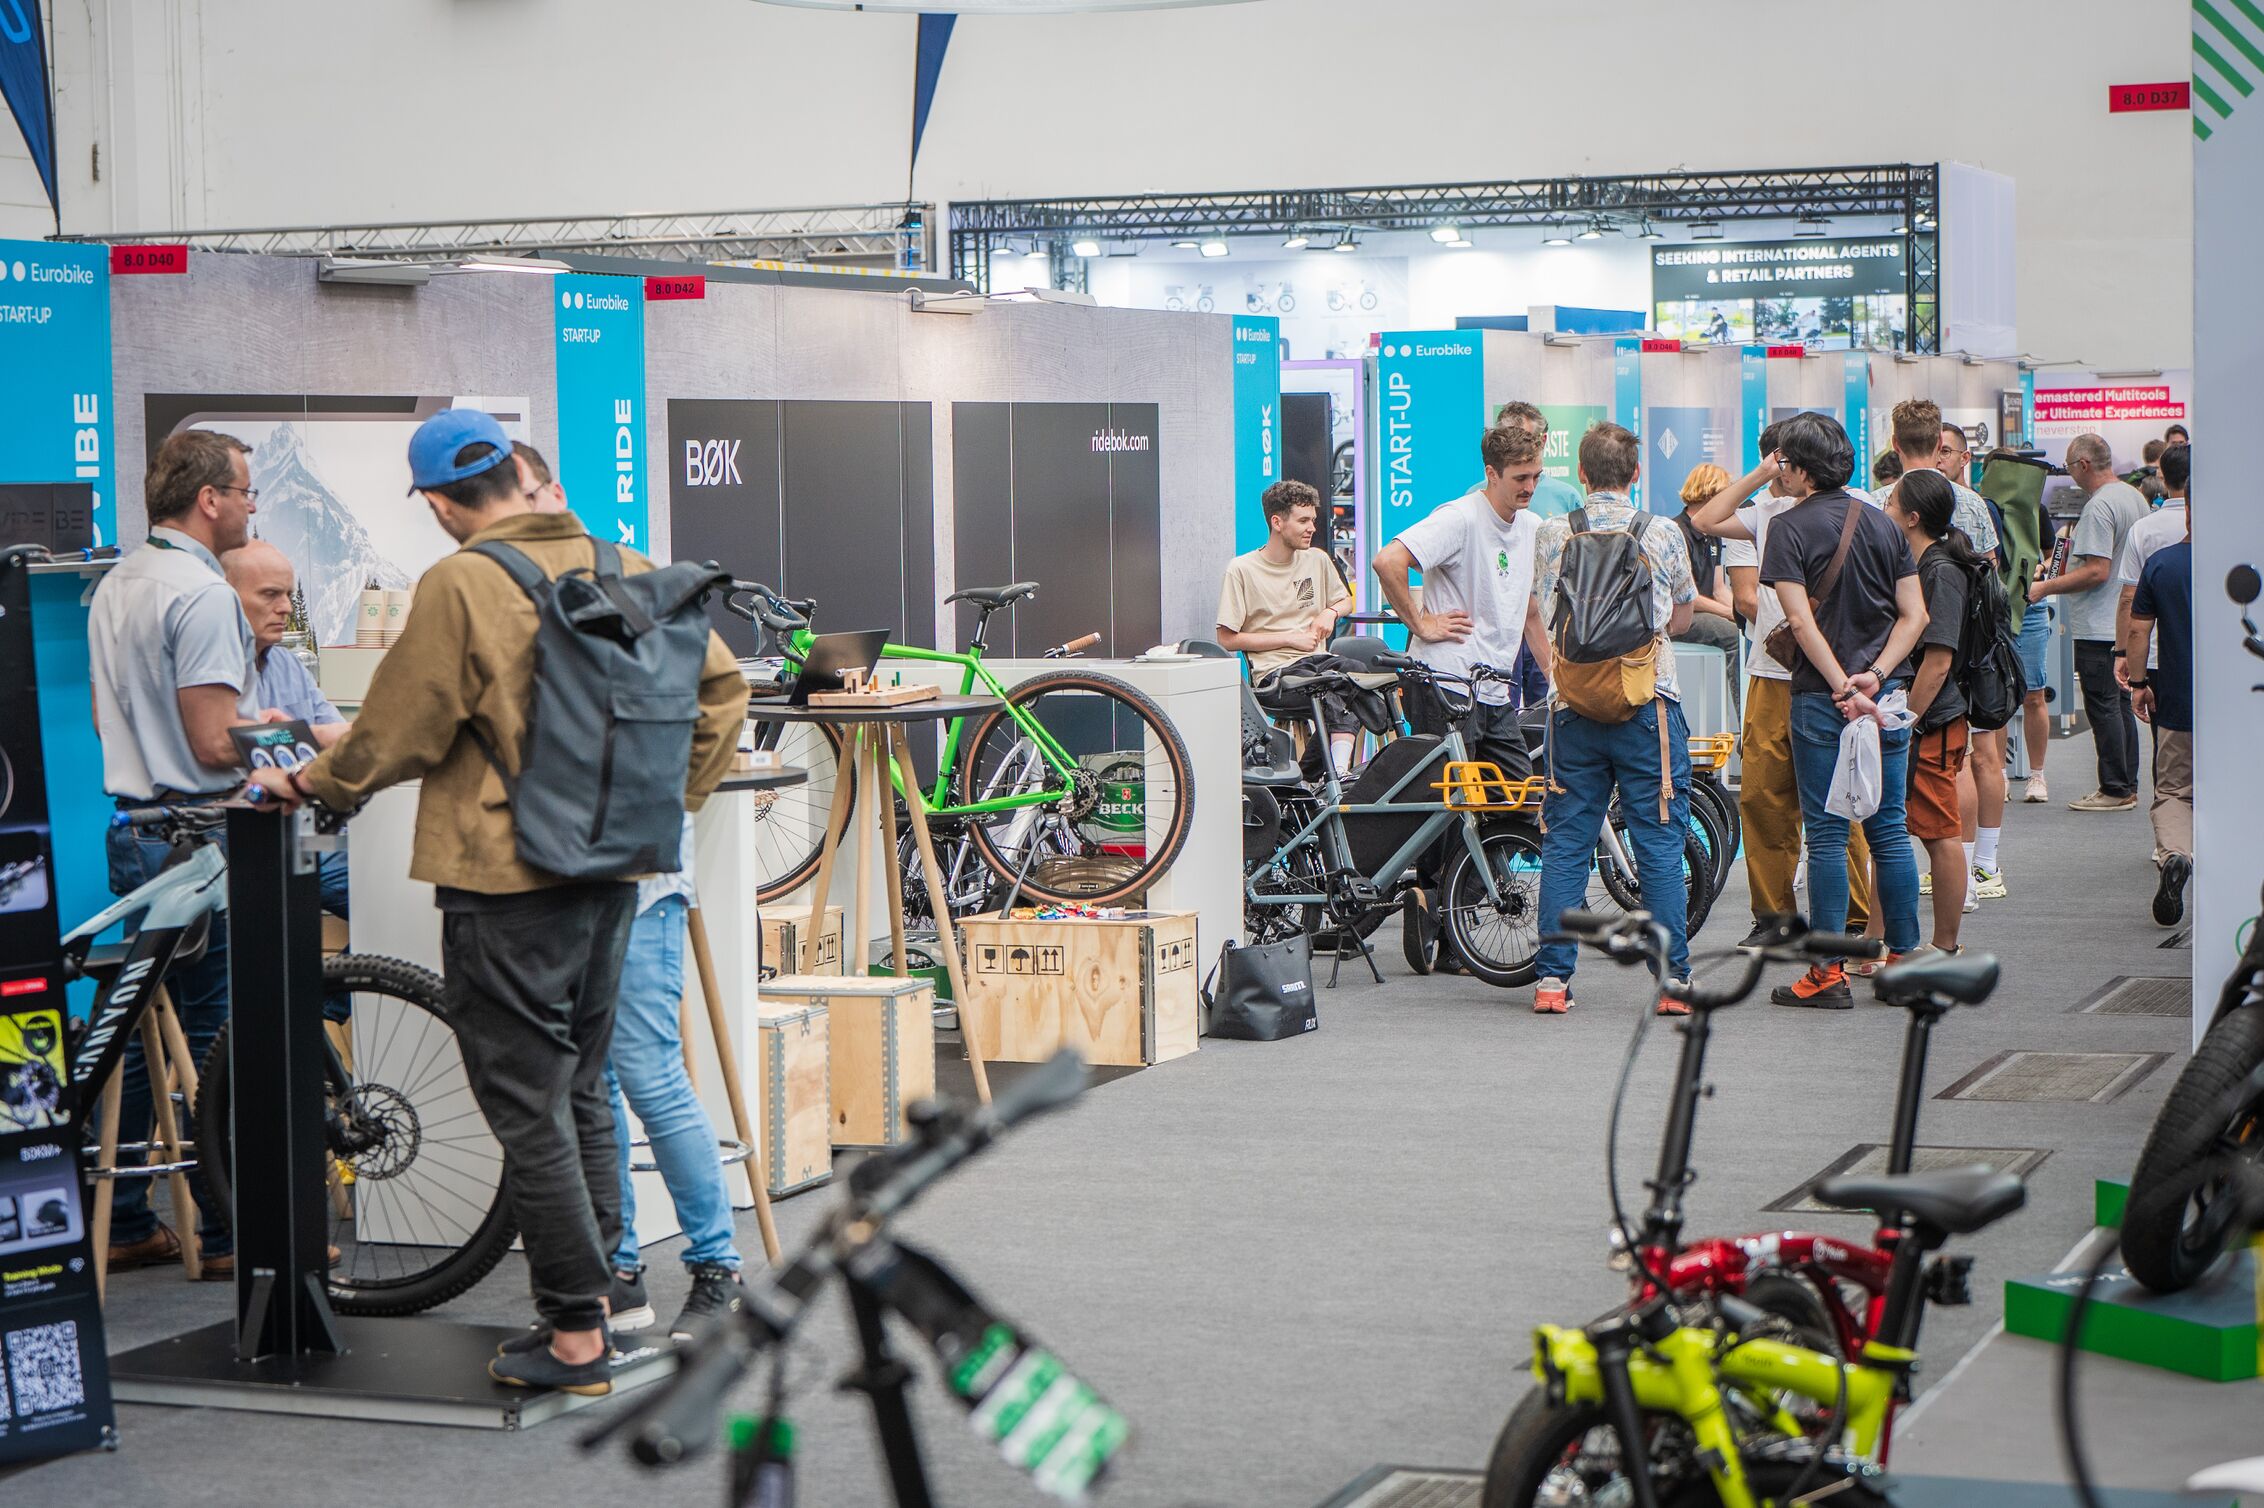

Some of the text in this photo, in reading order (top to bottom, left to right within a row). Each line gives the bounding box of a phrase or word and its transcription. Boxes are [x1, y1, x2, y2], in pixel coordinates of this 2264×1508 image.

[2123, 91, 2178, 105] 8.0 D37
[124, 253, 174, 266] 8.0 D40
[1655, 243, 1899, 266] SEEKING INTERNATIONAL AGENTS
[31, 262, 94, 284] Eurobike
[1706, 264, 1854, 284] & RETAIL PARTNERS
[655, 283, 695, 295] 8.0 D42
[586, 293, 629, 311] Eurobike
[562, 327, 601, 343] START-UP
[1248, 329, 1271, 342] Eurobike
[1416, 343, 1472, 357] Eurobike
[1236, 354, 1257, 365] START-UP
[2033, 390, 2102, 404] emastered
[2104, 388, 2167, 402] Multitools
[2034, 406, 2183, 420] or Ultimate Experiences
[1092, 428, 1149, 452] ridebok.com
[1388, 372, 1413, 507] START-UP
[1543, 430, 1569, 458] ASTE
[614, 399, 634, 503] RIDE
[685, 439, 743, 486] BØK
[2055, 541, 2064, 560] DAILY
[73, 955, 155, 1081] CANYON
